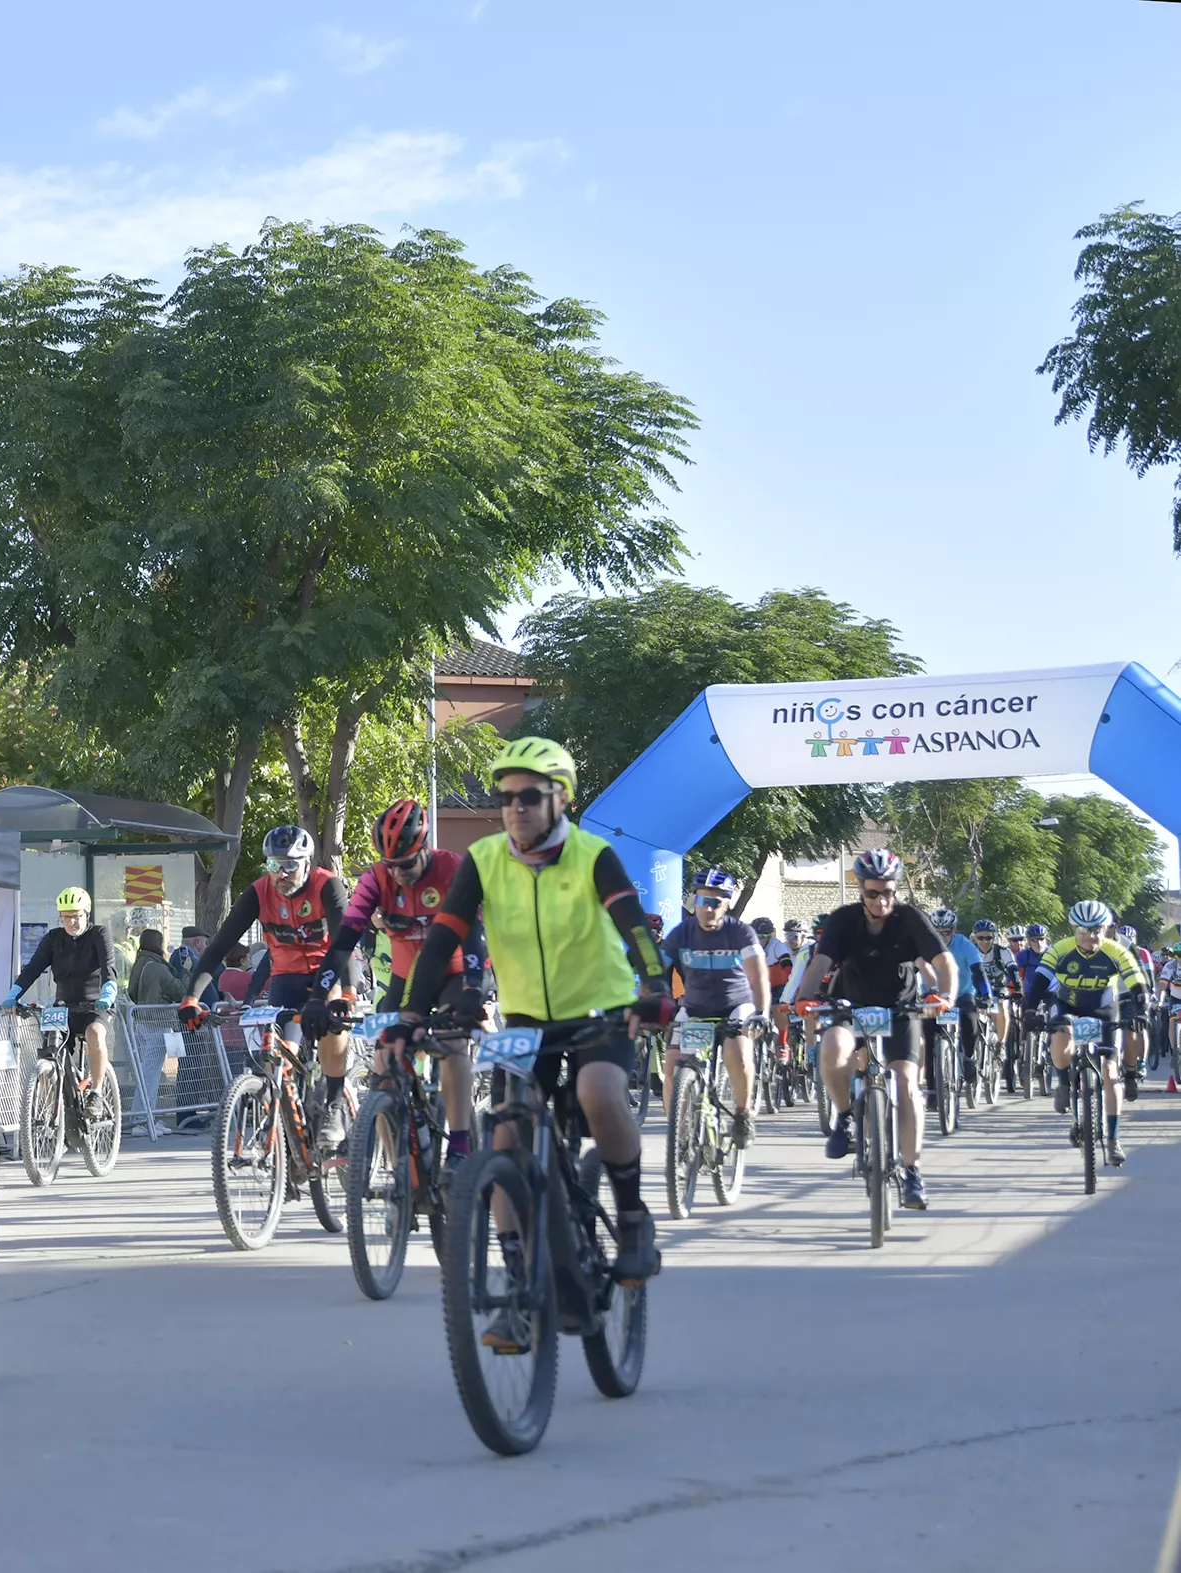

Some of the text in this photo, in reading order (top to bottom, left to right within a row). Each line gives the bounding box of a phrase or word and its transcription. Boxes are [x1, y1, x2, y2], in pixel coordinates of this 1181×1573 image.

[871, 700, 924, 720] con
[935, 693, 1038, 717] cáncer
[912, 727, 1041, 754] ASPANOA
[44, 1012, 65, 1022] 246
[858, 1012, 884, 1026] 301
[1075, 1023, 1099, 1035] 125
